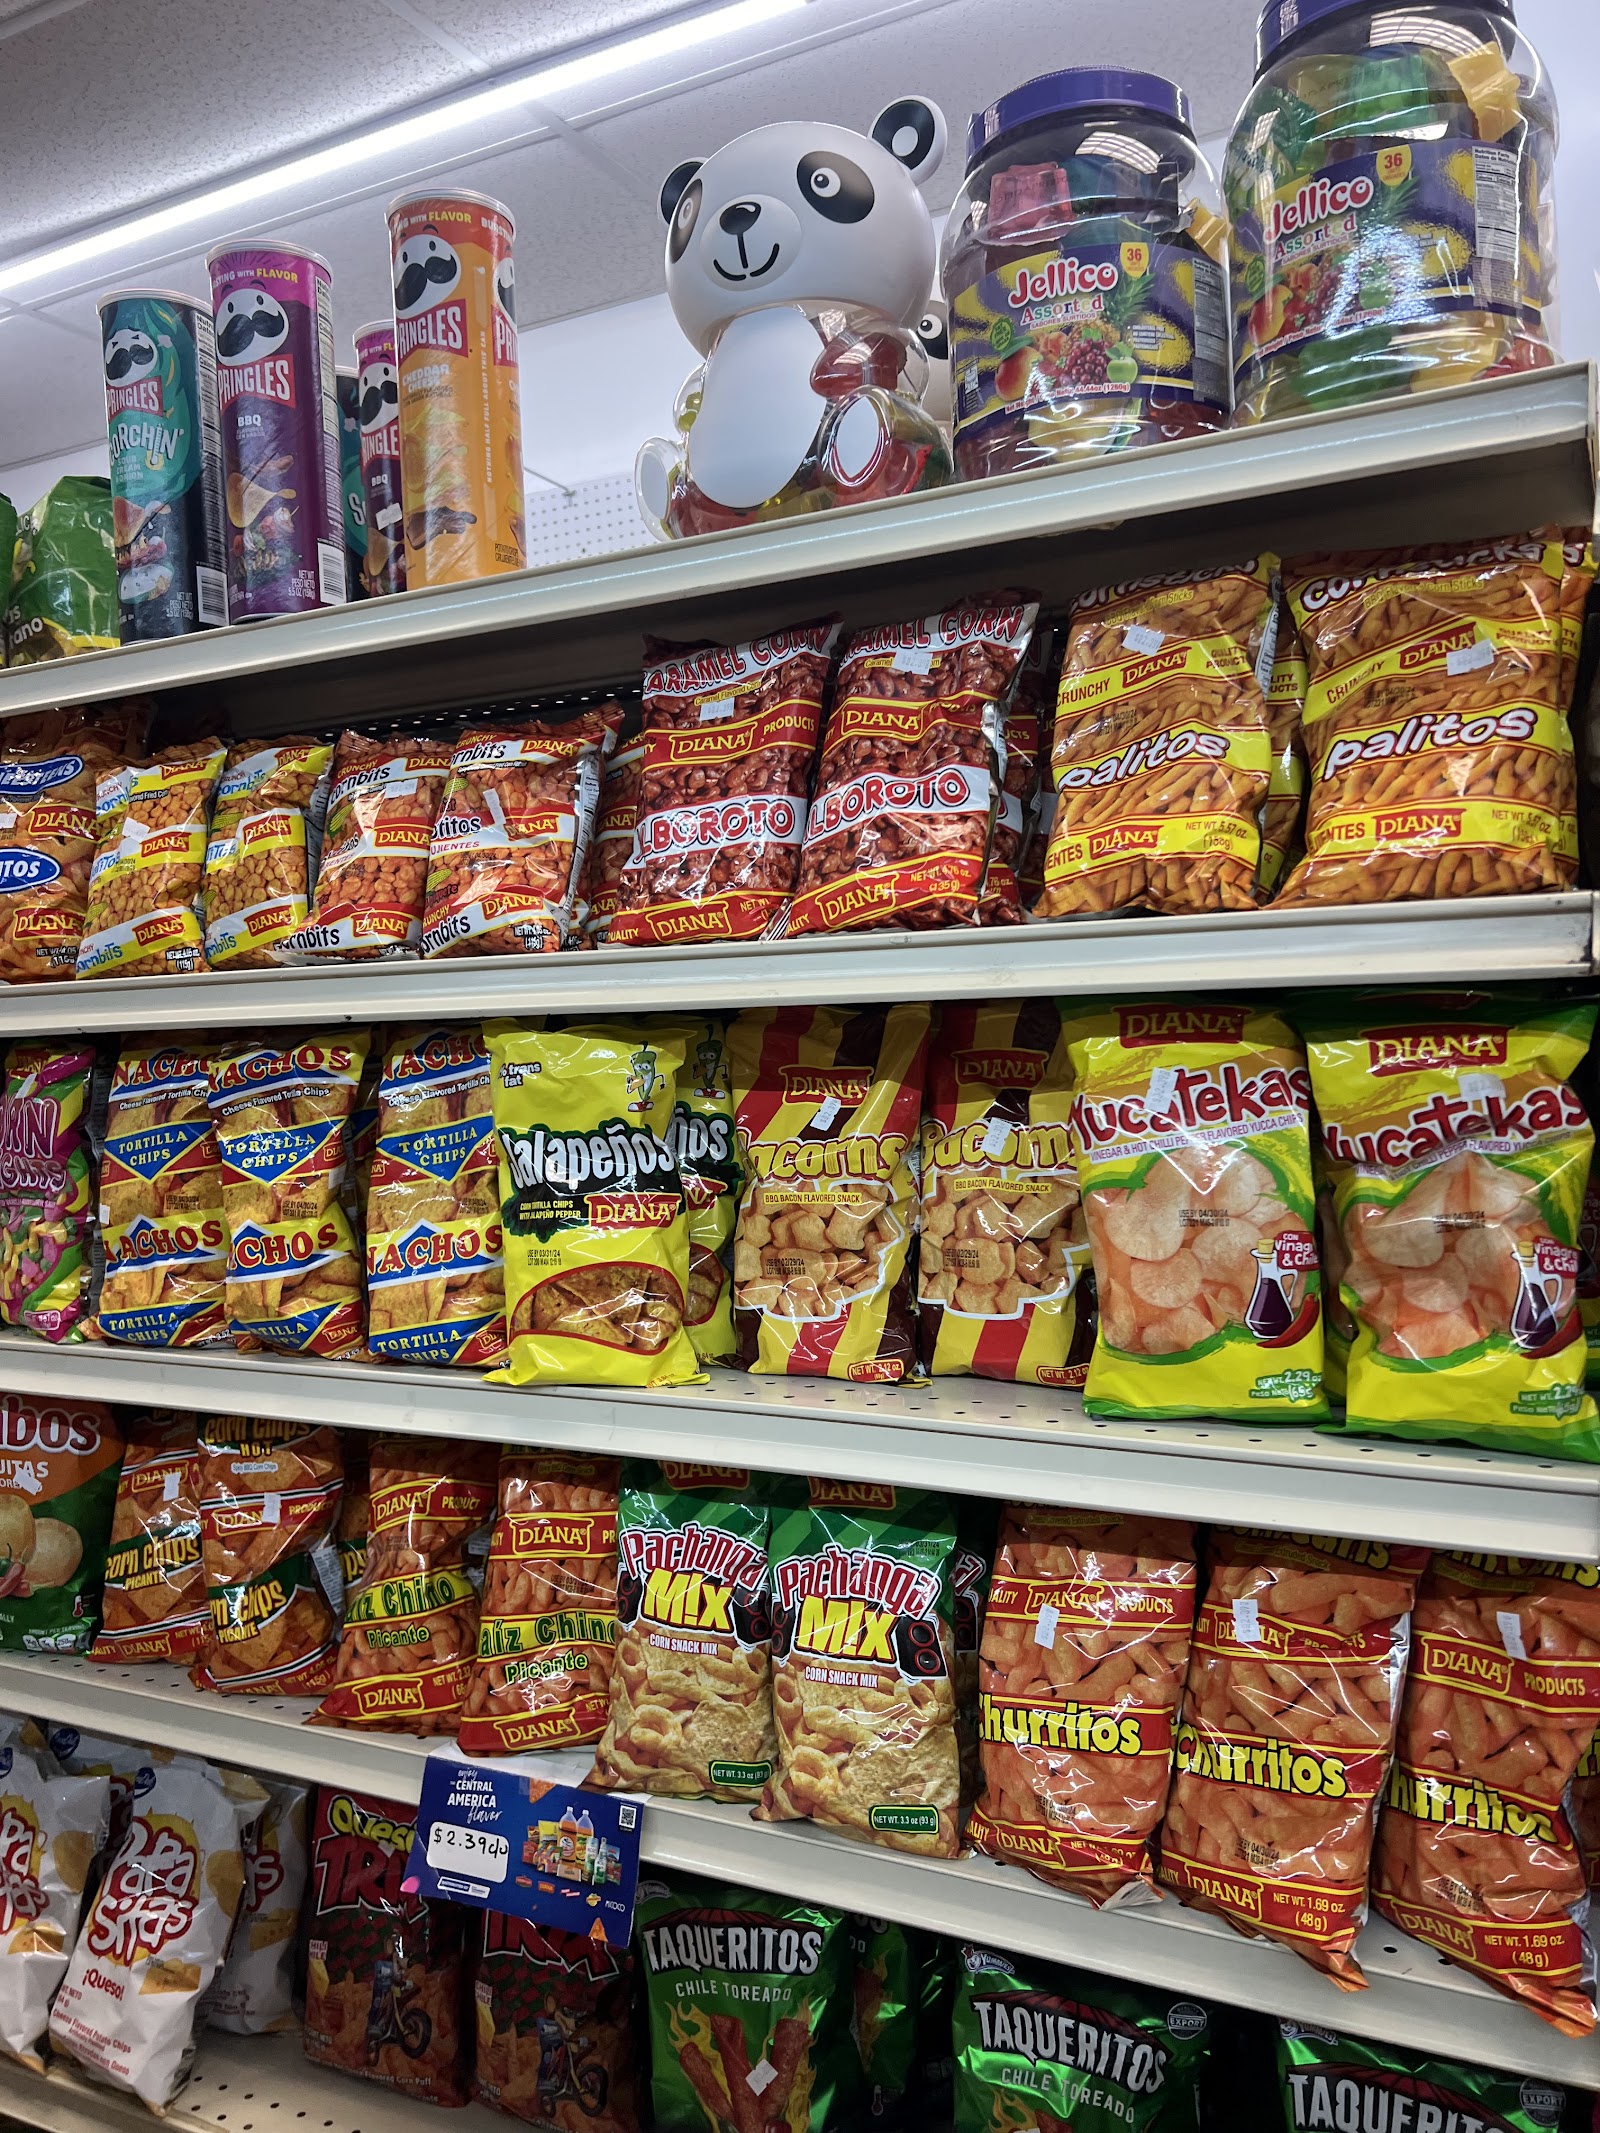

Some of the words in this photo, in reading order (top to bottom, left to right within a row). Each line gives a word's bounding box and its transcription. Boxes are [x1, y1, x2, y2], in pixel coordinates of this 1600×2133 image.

[1385, 153, 1402, 169] 36
[410, 214, 427, 223] WITH
[429, 211, 471, 223] FLAVOR
[1265, 178, 1372, 243] Jellico
[1275, 214, 1357, 259] Assorted
[1127, 248, 1142, 261] 36
[256, 268, 298, 283] FLAVOR
[1010, 258, 1117, 307] Jellico
[1021, 295, 1103, 325] Assorted
[1063, 313, 1095, 322] SURTIDOS
[218, 359, 289, 410] PRINGLES
[107, 381, 159, 420] PRINGLES
[238, 415, 261, 427] BBQ
[371, 474, 388, 486] BBQ
[1169, 589, 1193, 604] Sticks
[941, 605, 1024, 643] CORN
[1405, 633, 1471, 666] DIANA
[1126, 653, 1182, 684] DIANA
[721, 686, 746, 699] Flavored
[846, 713, 919, 730] DIANA
[679, 735, 747, 754] DIANA
[764, 717, 814, 735] PRODUCTS
[1324, 707, 1538, 781] palitos
[338, 760, 377, 778] CRUNCHY
[1059, 730, 1230, 789] palitos
[1380, 816, 1456, 834] DIANA
[1492, 809, 1509, 820] NET
[144, 835, 186, 852] DIANA
[1093, 831, 1154, 854] DIANA
[1186, 822, 1201, 830] NET
[1219, 821, 1236, 834] 5.57
[911, 871, 926, 882] NET
[826, 885, 887, 920] DIANA
[138, 922, 181, 941] DIANA
[657, 913, 722, 937] DIANA
[1126, 1011, 1236, 1038] DIANA
[1378, 1035, 1498, 1067] DIANA
[507, 1062, 542, 1075] trans
[965, 1059, 1037, 1079] DIANA
[504, 1076, 523, 1087] fat
[793, 1076, 862, 1098] DIANA
[222, 1102, 252, 1116] Cheese
[253, 1093, 282, 1107] Flavored
[303, 1087, 330, 1096] Chips
[119, 1130, 188, 1154] TORTILLA
[226, 1134, 316, 1155] TORTILLA
[399, 1126, 477, 1153] TORTILLA
[1091, 1147, 1122, 1162] VINEGAR
[1123, 1146, 1131, 1155] &
[1131, 1143, 1148, 1152] HOT
[1150, 1139, 1174, 1150] CHILLI
[1208, 1126, 1249, 1140] FLAVORED
[1250, 1120, 1278, 1133] YUCCA
[1278, 1112, 1304, 1127] CHIPS
[130, 1149, 170, 1167] CHIPS
[242, 1152, 298, 1169] CHIPS
[419, 1147, 466, 1168] CHIPS
[502, 1123, 675, 1190] Jalapeños
[955, 1180, 968, 1189] BBQ
[969, 1181, 990, 1190] BACON
[991, 1181, 1024, 1192] FLAVORED
[1025, 1183, 1049, 1193] SNACK
[765, 1193, 779, 1204] BBQ
[780, 1193, 802, 1203] BACON
[803, 1193, 835, 1203] FLAVORED
[837, 1193, 860, 1203] SNACK
[555, 1210, 581, 1219] PEPPER
[597, 1204, 670, 1224] DIANA
[1283, 1233, 1299, 1241] CON
[539, 1250, 560, 1258] 03/31/24
[781, 1258, 805, 1267] 02/29/24
[1282, 1254, 1293, 1267] &
[1543, 1258, 1553, 1271] &
[377, 1330, 462, 1351] TORTILLA
[852, 1364, 865, 1376] NET
[865, 1365, 876, 1376] WT.
[1040, 1369, 1054, 1379] NET
[1055, 1370, 1067, 1379] WT.
[1068, 1368, 1083, 1378] 2.12
[1284, 1371, 1310, 1383] 2.29
[240, 1442, 272, 1456] HOT
[377, 1494, 422, 1520] DIANA
[518, 1525, 583, 1546] DIANA
[143, 1536, 200, 1569] chips
[623, 1525, 768, 1590] Pachanga
[779, 1550, 940, 1617] Pachanga
[1032, 1592, 1090, 1608] DIANA
[367, 1624, 430, 1648] Picante
[649, 1634, 670, 1650] CORN
[671, 1637, 701, 1654] SNACK
[702, 1641, 718, 1656] MIX
[505, 1653, 588, 1685] Picante
[805, 1666, 827, 1681] CORN
[828, 1670, 859, 1686] SNACK
[860, 1674, 878, 1688] MIX
[1430, 1648, 1503, 1684] DIANA
[1524, 1671, 1586, 1697] PRODUCTS
[366, 1688, 419, 1708] DIANA
[505, 1717, 572, 1744] DIANA
[712, 1769, 726, 1778] NET
[726, 1769, 736, 1779] WT.
[737, 1770, 746, 1779] 3.3
[747, 1771, 754, 1779] oz
[1177, 1731, 1347, 1798] Churritos
[456, 1781, 493, 1791] CENTRAL
[447, 1793, 496, 1807] AMERICA
[467, 1806, 503, 1824] flavor
[874, 1815, 887, 1824] NET
[888, 1815, 900, 1825] WT.
[900, 1816, 910, 1825] 3.3
[910, 1816, 918, 1825] oz
[919, 1815, 928, 1826] (93
[1002, 1834, 1057, 1854] DIANA
[1193, 1875, 1257, 1912] DIANA
[1273, 1892, 1289, 1905] NET
[1290, 1894, 1306, 1907] WT.
[1307, 1896, 1329, 1911] 1.69
[1330, 1900, 1346, 1913] oz.
[1295, 1909, 1327, 1932] (48g)
[1402, 1911, 1465, 1949] DIANA
[1484, 1933, 1504, 1947] NET
[1505, 1935, 1522, 1948] WT.
[1522, 1934, 1549, 1948] 1.69
[1550, 1935, 1566, 1946] oz.
[643, 1923, 822, 1975] TAQUERITOS
[1512, 1950, 1550, 1969] (48g)
[82, 1969, 125, 2001] ¡Queso!
[675, 1979, 718, 1997] CHILE
[723, 1982, 792, 2002] TOREADO
[1169, 2016, 1204, 2028] EXPORT
[112, 2039, 131, 2053] Chips
[973, 2002, 1166, 2094] TAQUERITOS
[1001, 2068, 1052, 2091] CHILE
[1061, 2078, 1135, 2124] TOREADO
[1522, 2094, 1565, 2107] EXPORT
